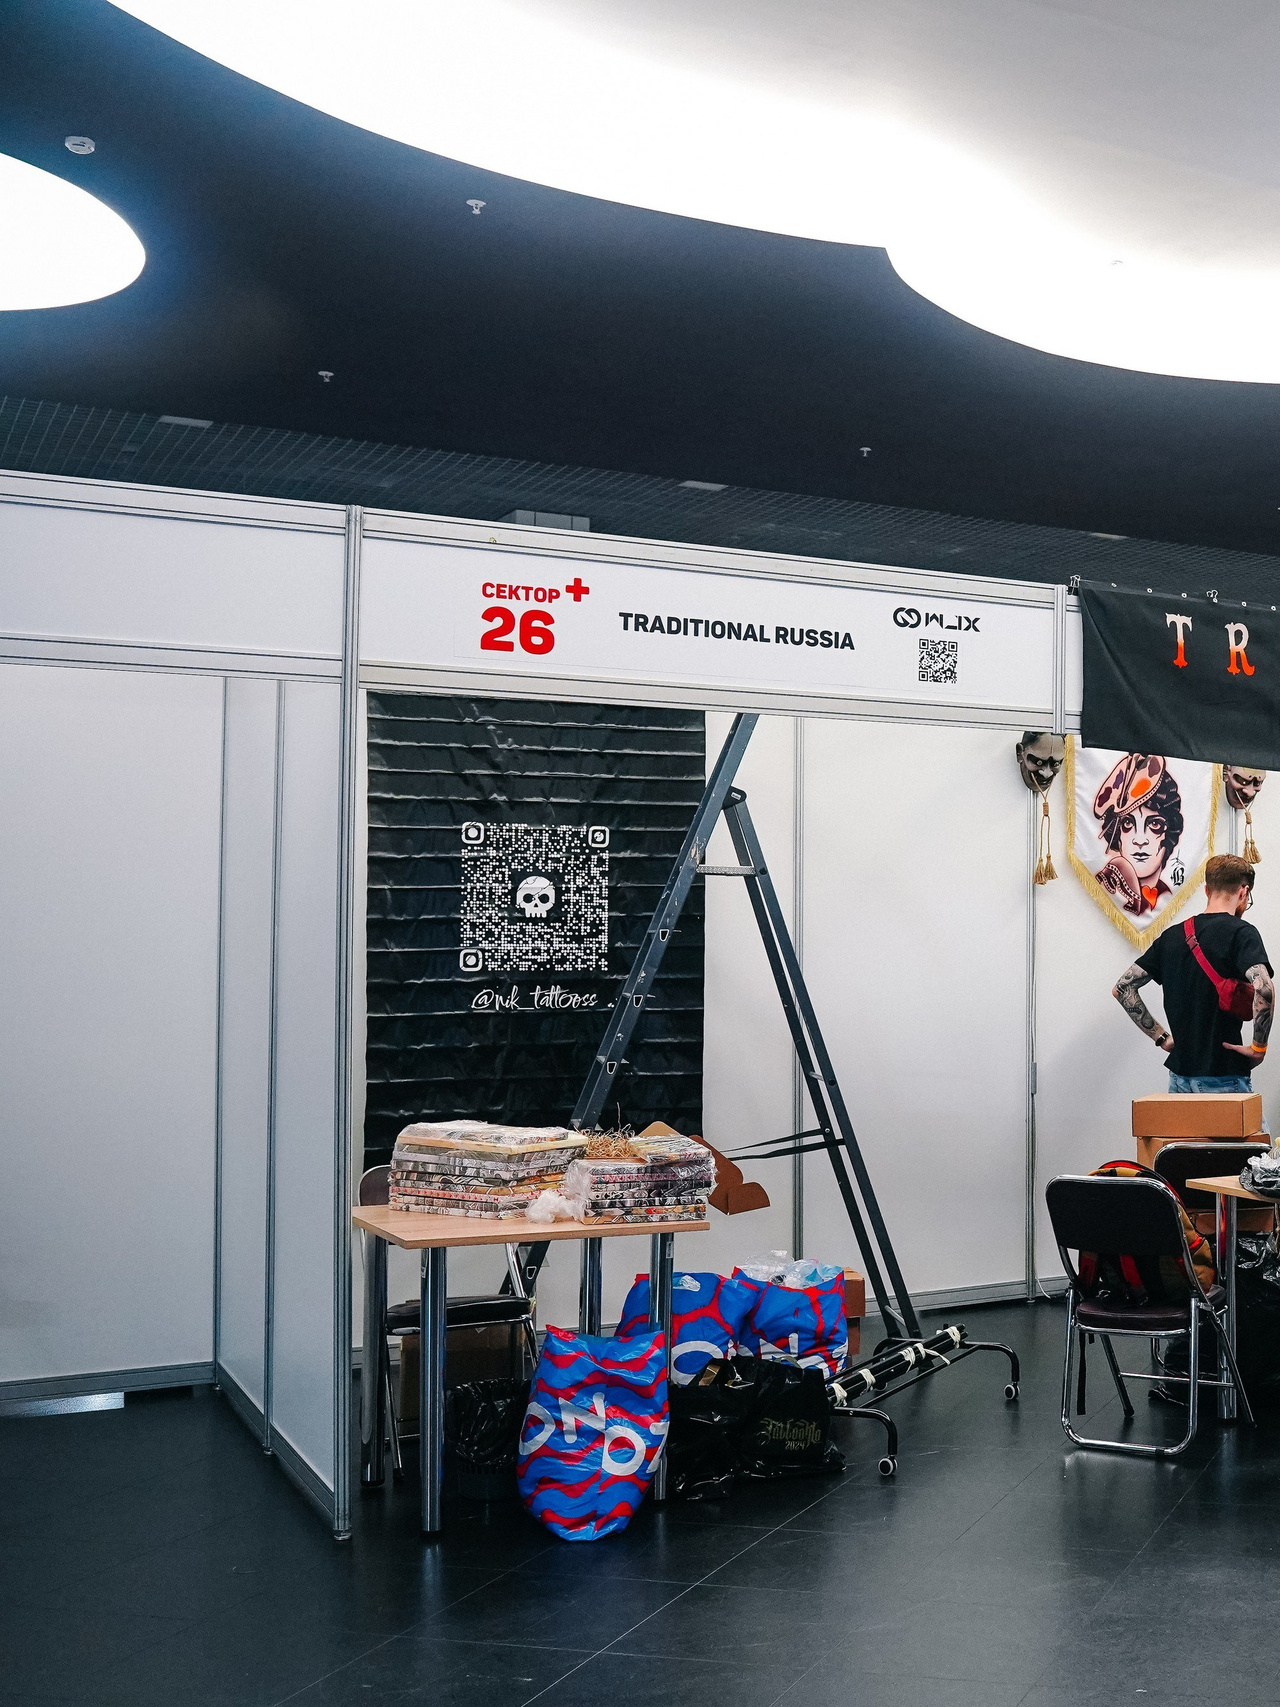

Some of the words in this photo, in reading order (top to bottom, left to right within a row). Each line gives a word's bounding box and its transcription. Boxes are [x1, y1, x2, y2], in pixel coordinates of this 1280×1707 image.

[481, 582, 561, 603] СЕКТОР
[479, 606, 556, 655] 26
[618, 611, 771, 645] TRADITIONAL
[774, 626, 856, 651] RUSSIA
[784, 1441, 806, 1451] 2024
